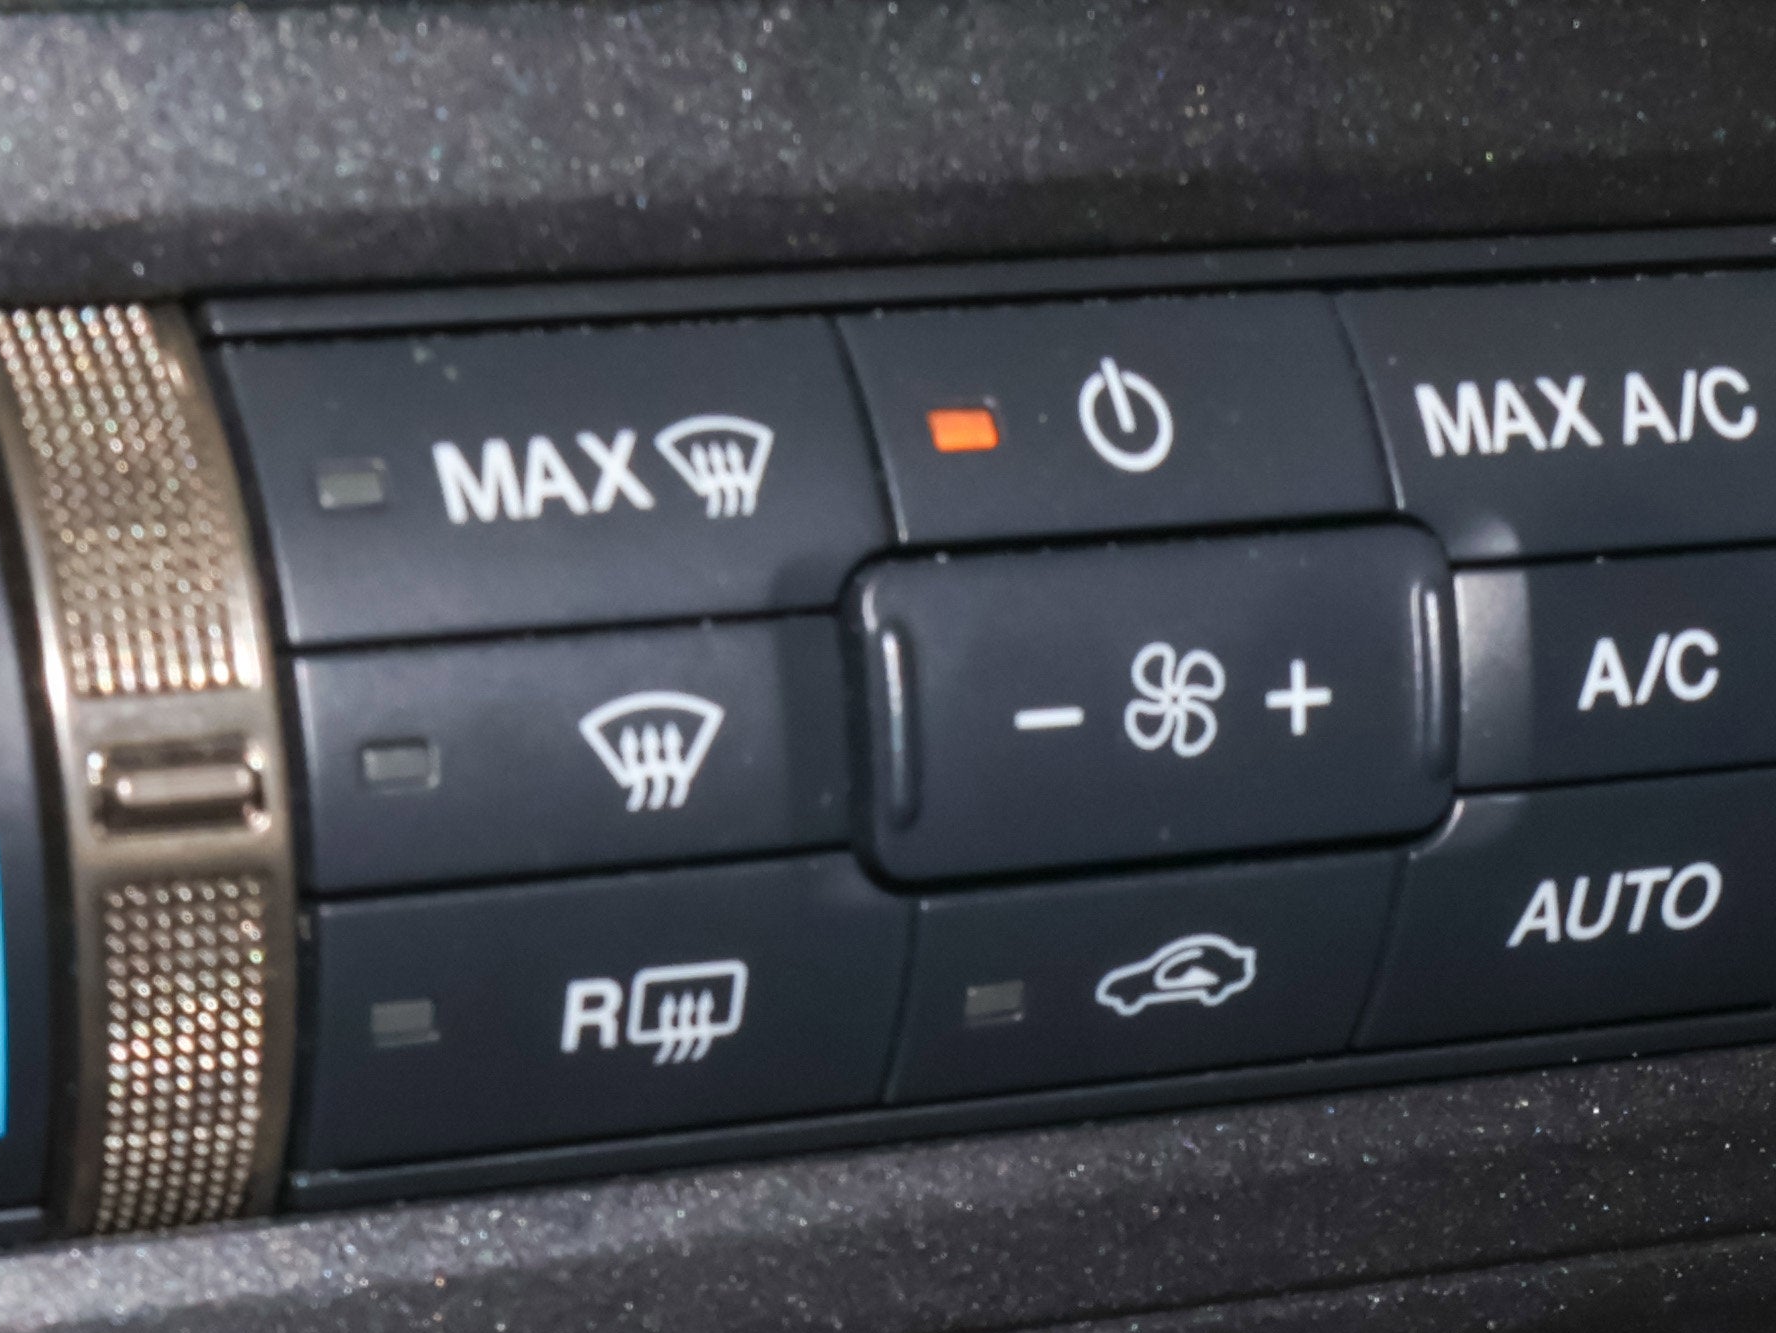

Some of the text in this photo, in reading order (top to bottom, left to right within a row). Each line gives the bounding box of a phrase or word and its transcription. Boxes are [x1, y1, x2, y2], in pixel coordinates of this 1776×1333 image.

[1413, 365, 1759, 459] MAX A/C
[430, 432, 654, 528] MAX
[1577, 627, 1720, 712] A/C
[1507, 861, 1723, 948] AUTO
[560, 977, 624, 1053] R
